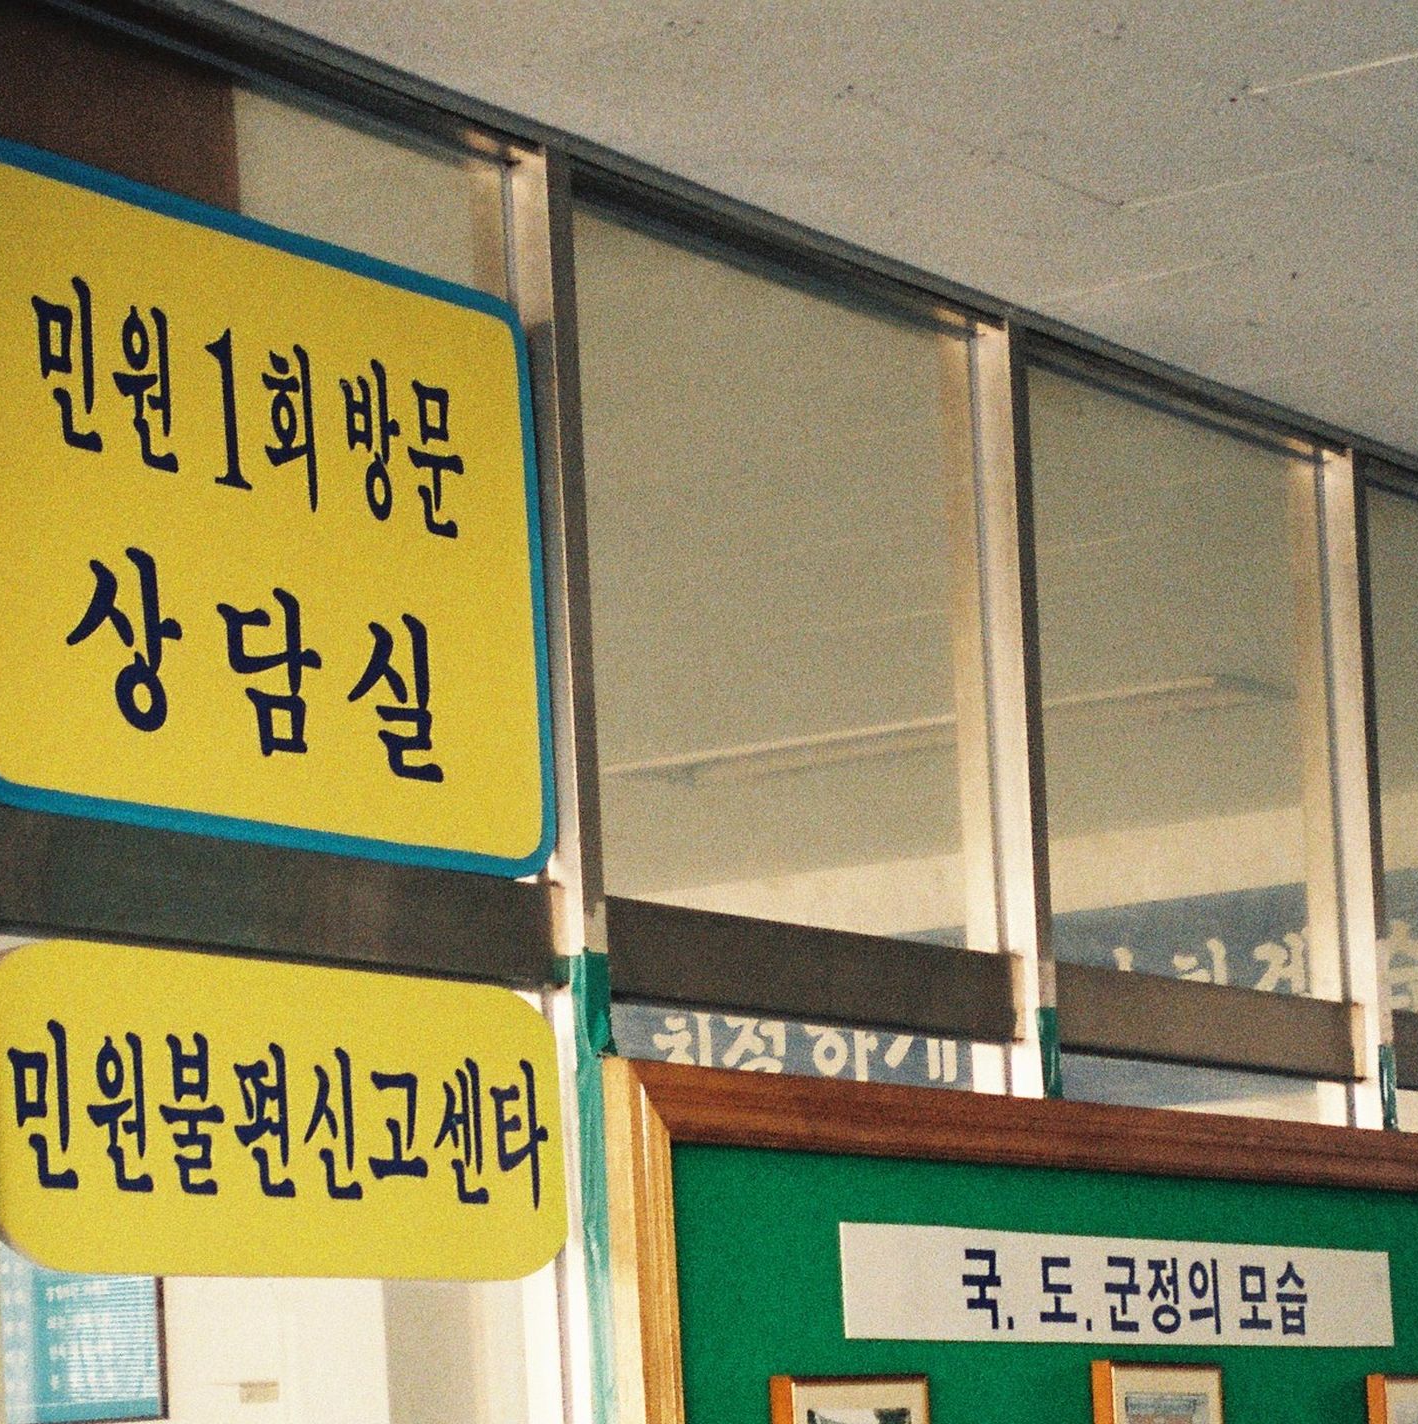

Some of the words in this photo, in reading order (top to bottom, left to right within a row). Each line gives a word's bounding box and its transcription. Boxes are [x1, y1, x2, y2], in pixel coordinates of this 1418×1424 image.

[31, 275, 179, 474] 민원
[204, 327, 321, 513] 1회
[338, 358, 466, 538] 방문
[65, 546, 446, 783] 상담실
[6, 1018, 549, 1211] 민원불편신고센타
[1238, 1260, 1309, 1336] 모습
